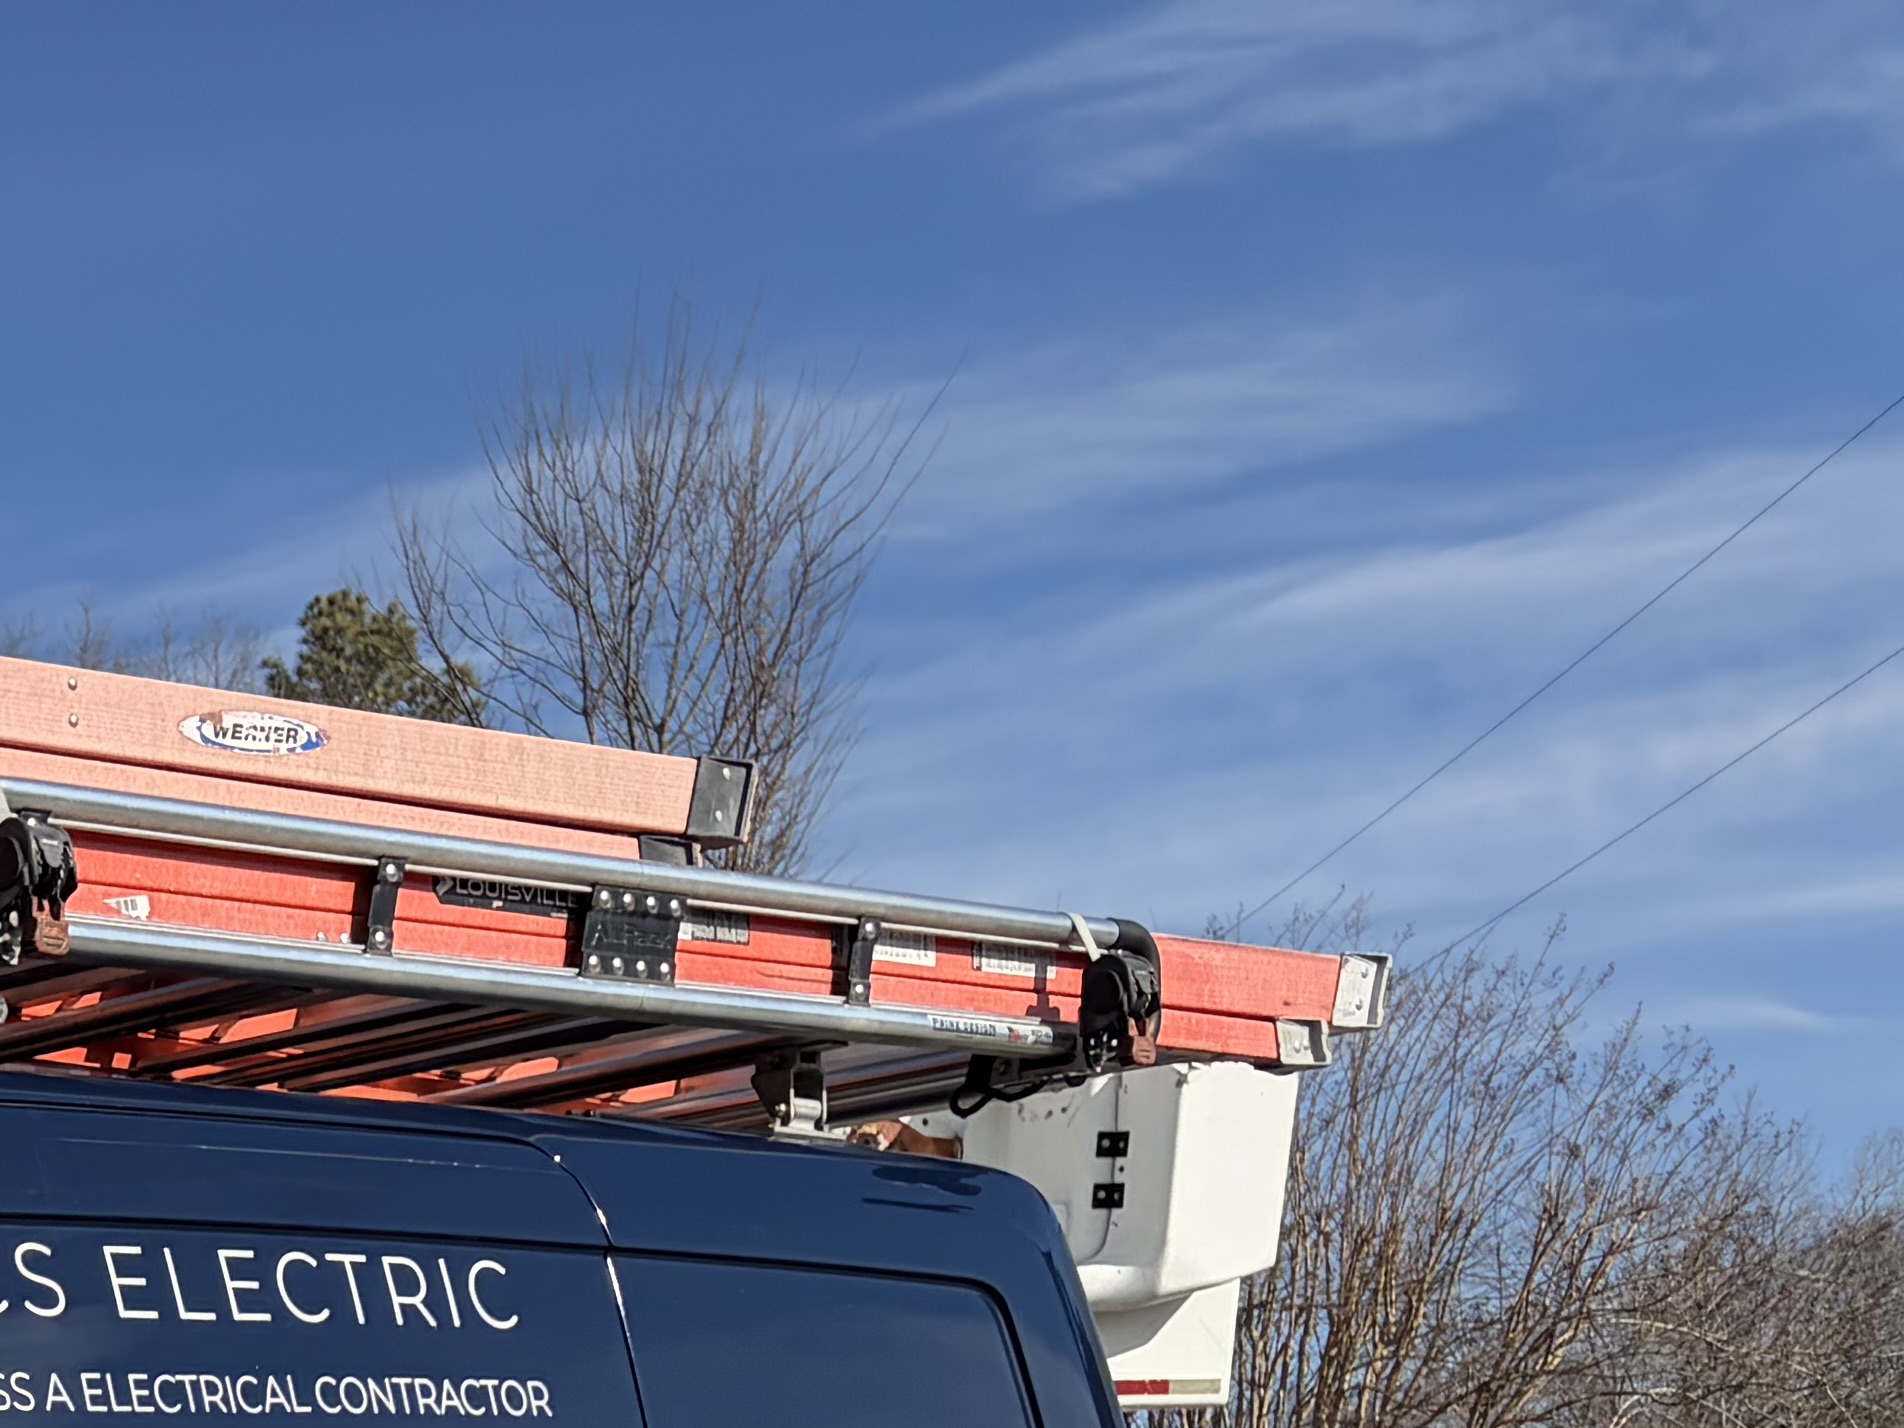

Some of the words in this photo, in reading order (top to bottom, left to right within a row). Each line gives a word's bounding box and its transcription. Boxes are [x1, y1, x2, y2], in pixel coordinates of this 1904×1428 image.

[102, 1245, 519, 1330] ELECTRIC
[45, 1372, 75, 1412] A
[80, 1372, 312, 1414] ELECTRICAL
[314, 1375, 553, 1417] CONTRACTOR
